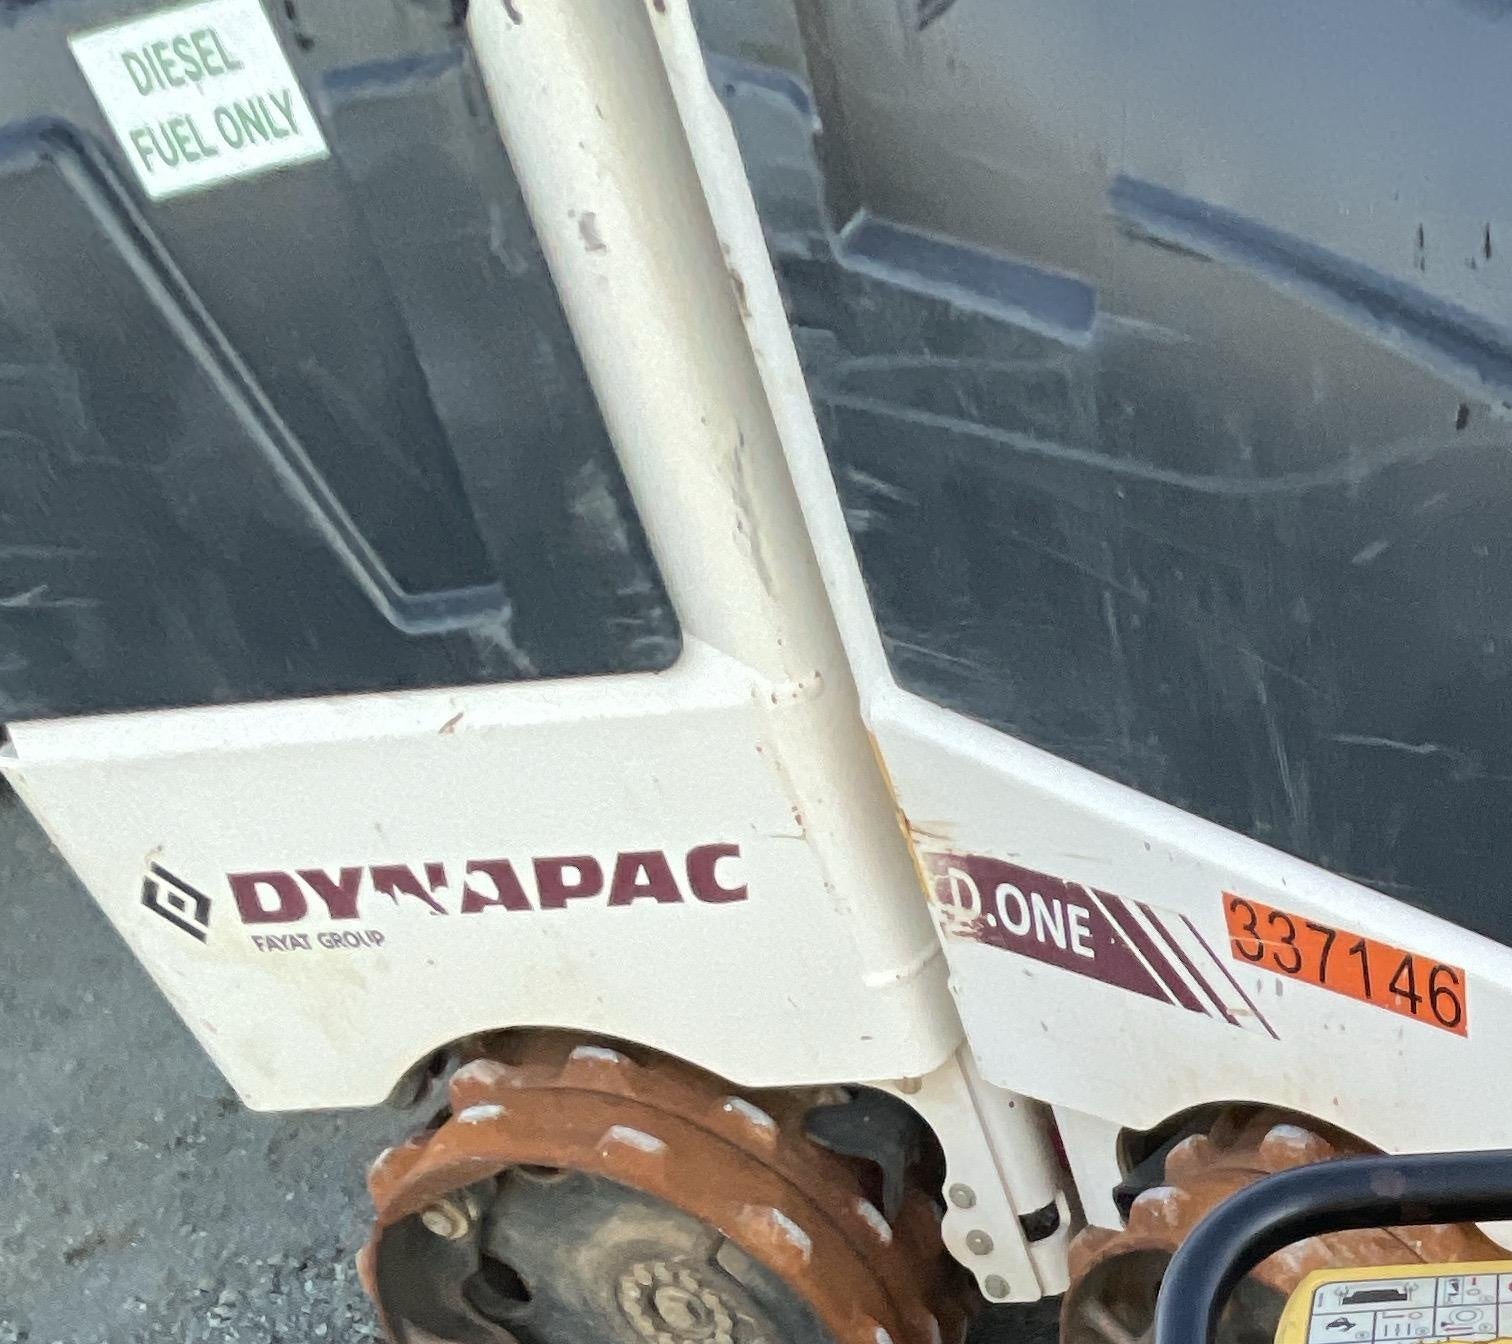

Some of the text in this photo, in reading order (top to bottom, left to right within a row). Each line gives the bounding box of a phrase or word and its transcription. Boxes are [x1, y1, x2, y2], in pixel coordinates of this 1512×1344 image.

[121, 25, 245, 96] DIESEL
[130, 87, 300, 173] FUEL ONLY
[250, 929, 385, 952] FAYAT GROUP
[1229, 897, 1462, 1028] 337146
